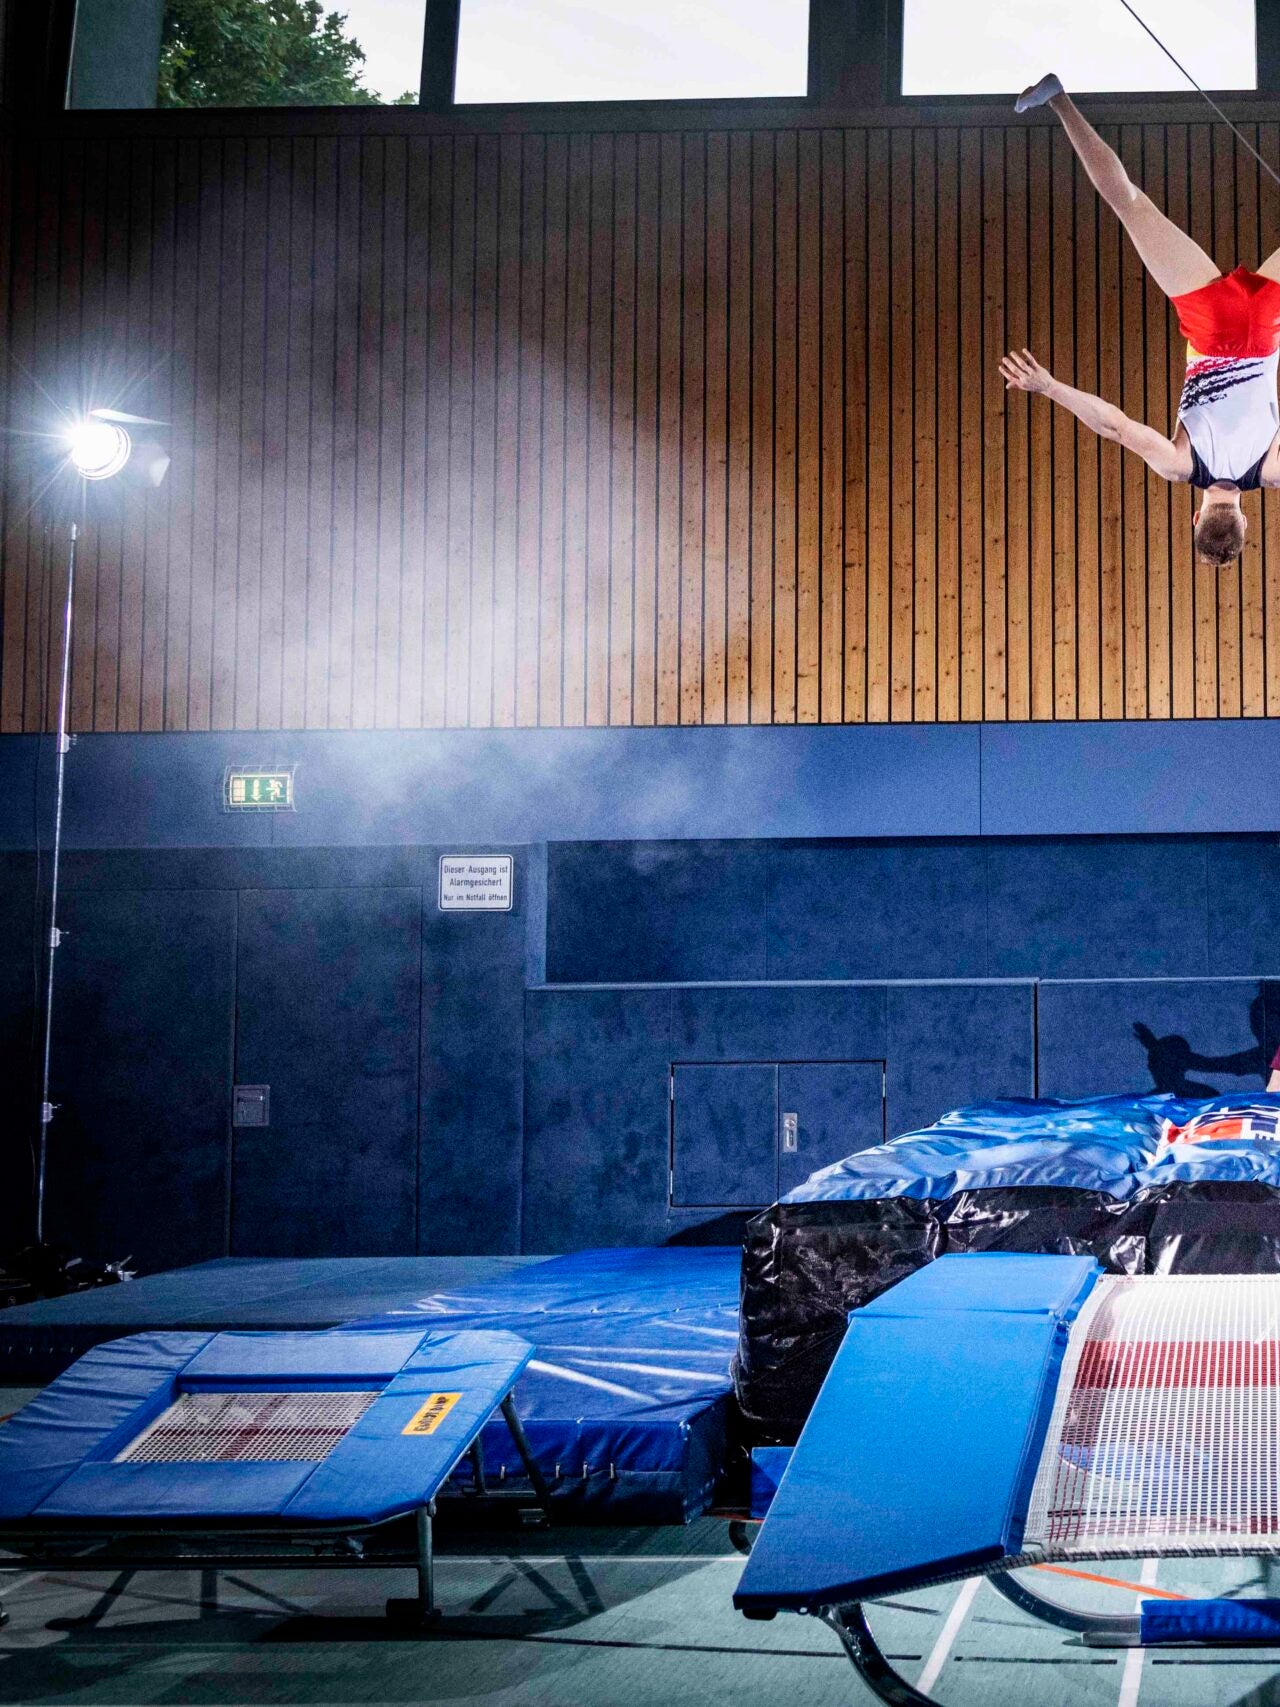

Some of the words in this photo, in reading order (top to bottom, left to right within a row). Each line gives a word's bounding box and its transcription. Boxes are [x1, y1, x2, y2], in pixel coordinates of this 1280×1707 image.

[444, 865, 465, 874] Dieser
[468, 865, 497, 875] Ausgang
[499, 865, 508, 874] ist
[449, 878, 502, 888] Alarmgesichert
[466, 893, 486, 901] Notfall
[488, 893, 508, 901] öffnen
